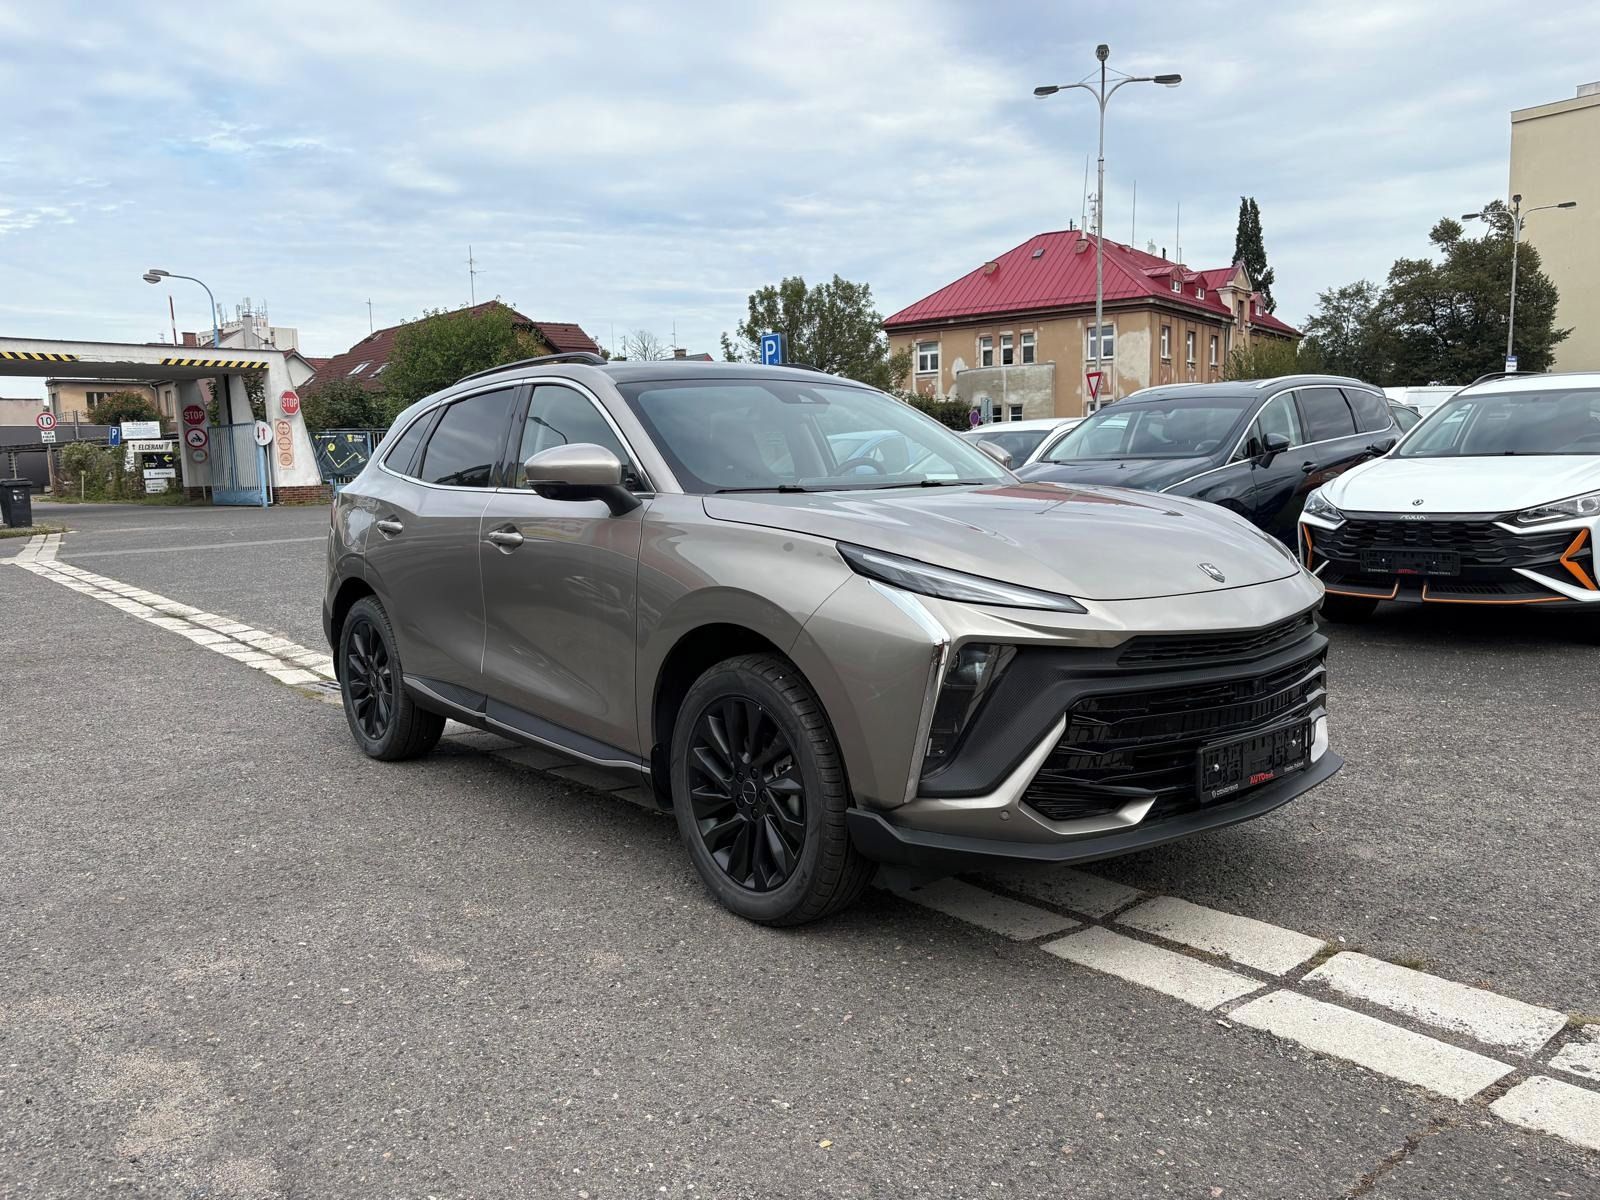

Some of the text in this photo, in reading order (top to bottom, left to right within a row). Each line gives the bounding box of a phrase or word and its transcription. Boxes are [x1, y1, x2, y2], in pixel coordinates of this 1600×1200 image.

[765, 340, 776, 365] P
[282, 398, 298, 407] STOP
[183, 411, 204, 420] STOP
[40, 416, 52, 426] 10
[111, 428, 117, 439] P
